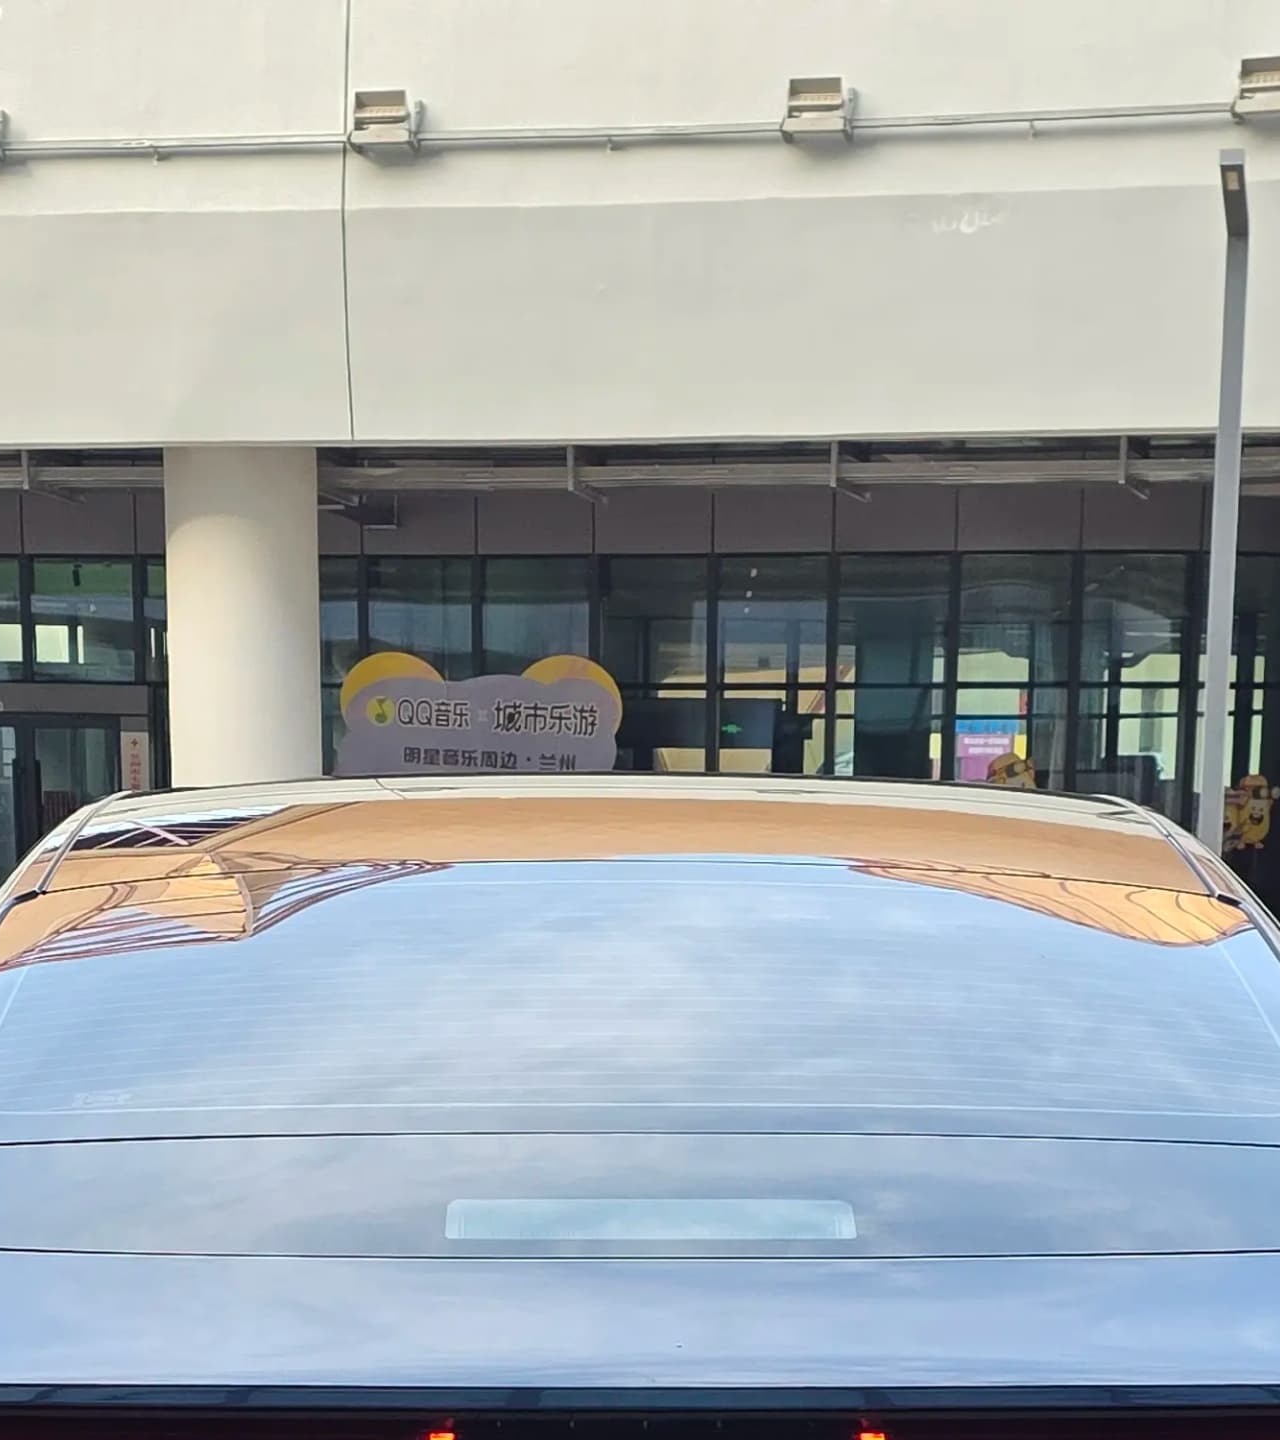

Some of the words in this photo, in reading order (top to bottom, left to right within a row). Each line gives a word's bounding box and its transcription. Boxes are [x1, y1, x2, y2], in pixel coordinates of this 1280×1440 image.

[398, 698, 470, 728] QQ音乐
[493, 700, 598, 736] 城市乐游
